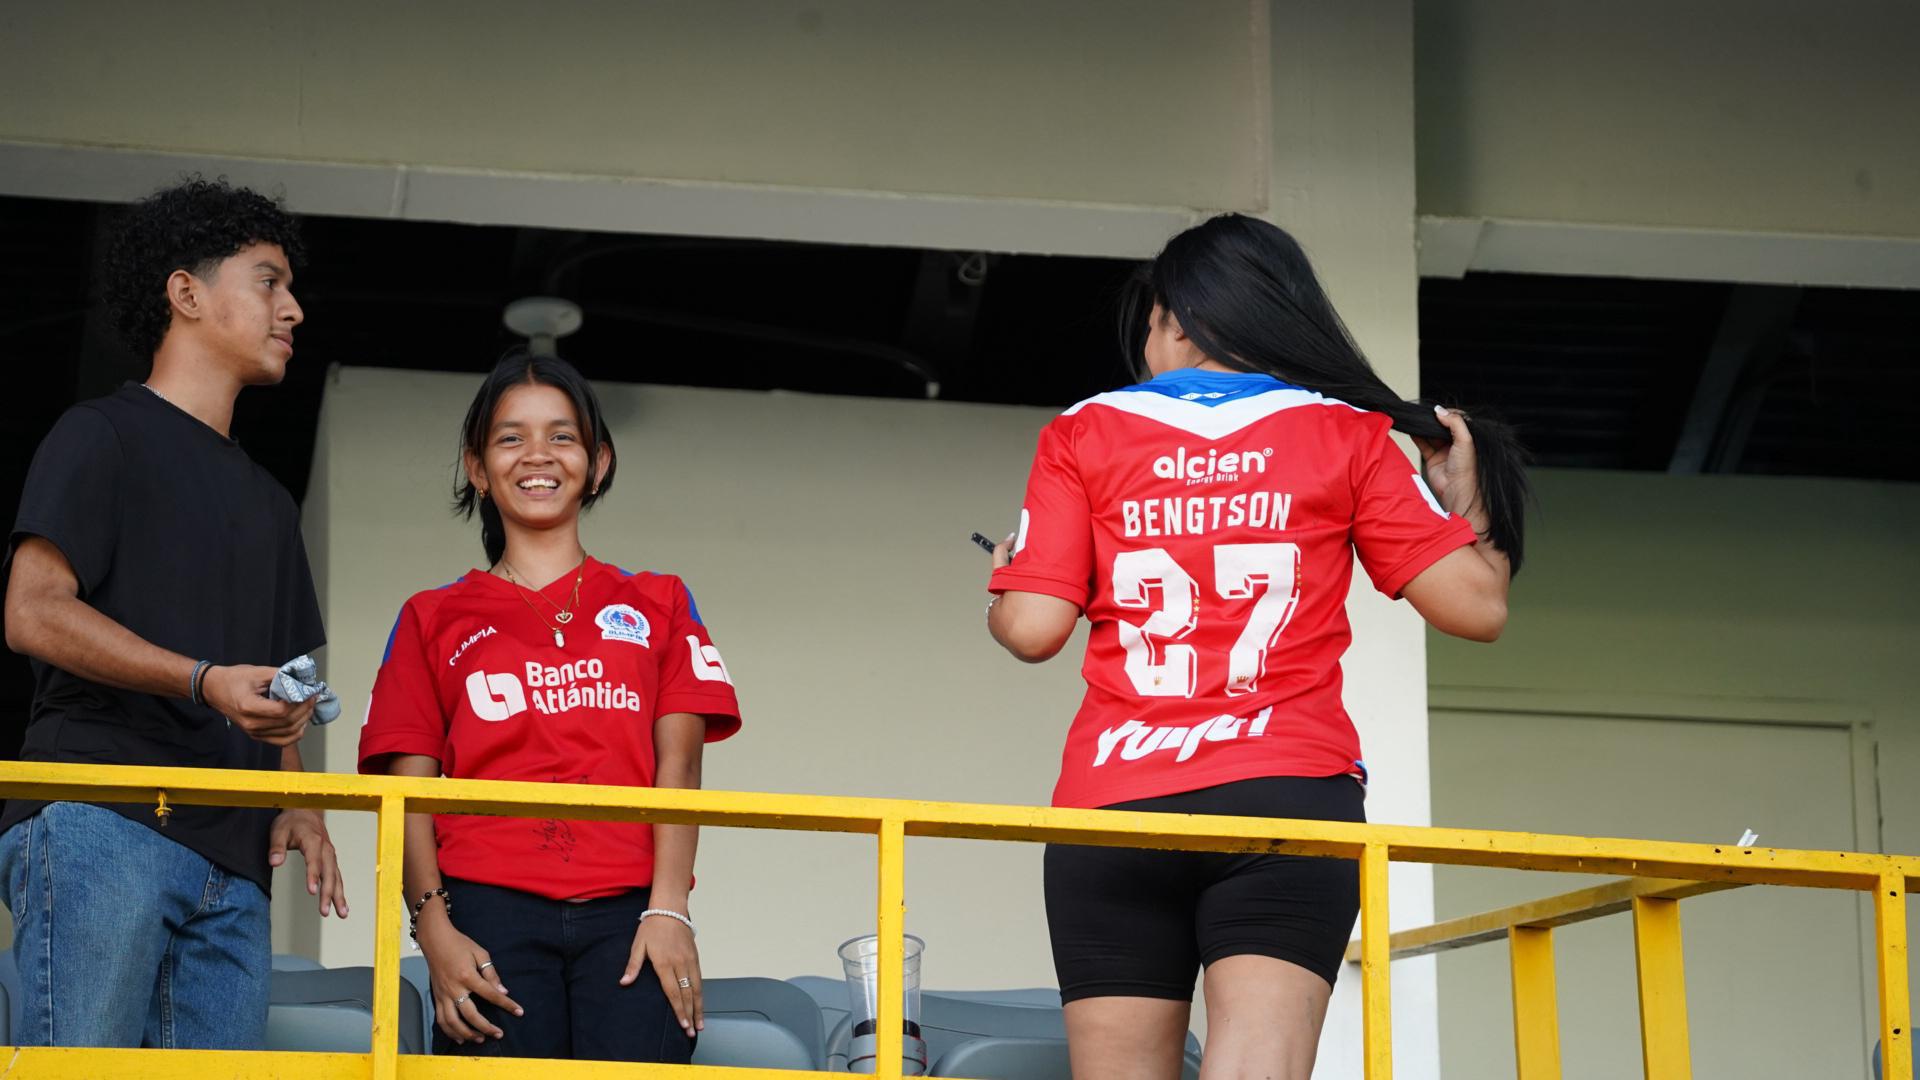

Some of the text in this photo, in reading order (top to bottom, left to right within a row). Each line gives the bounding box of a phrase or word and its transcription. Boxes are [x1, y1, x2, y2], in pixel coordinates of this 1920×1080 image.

[1123, 491, 1292, 537] BENGTSON
[1112, 542, 1301, 698] 27
[525, 658, 604, 687] Banco
[532, 681, 641, 715] Atlántida
